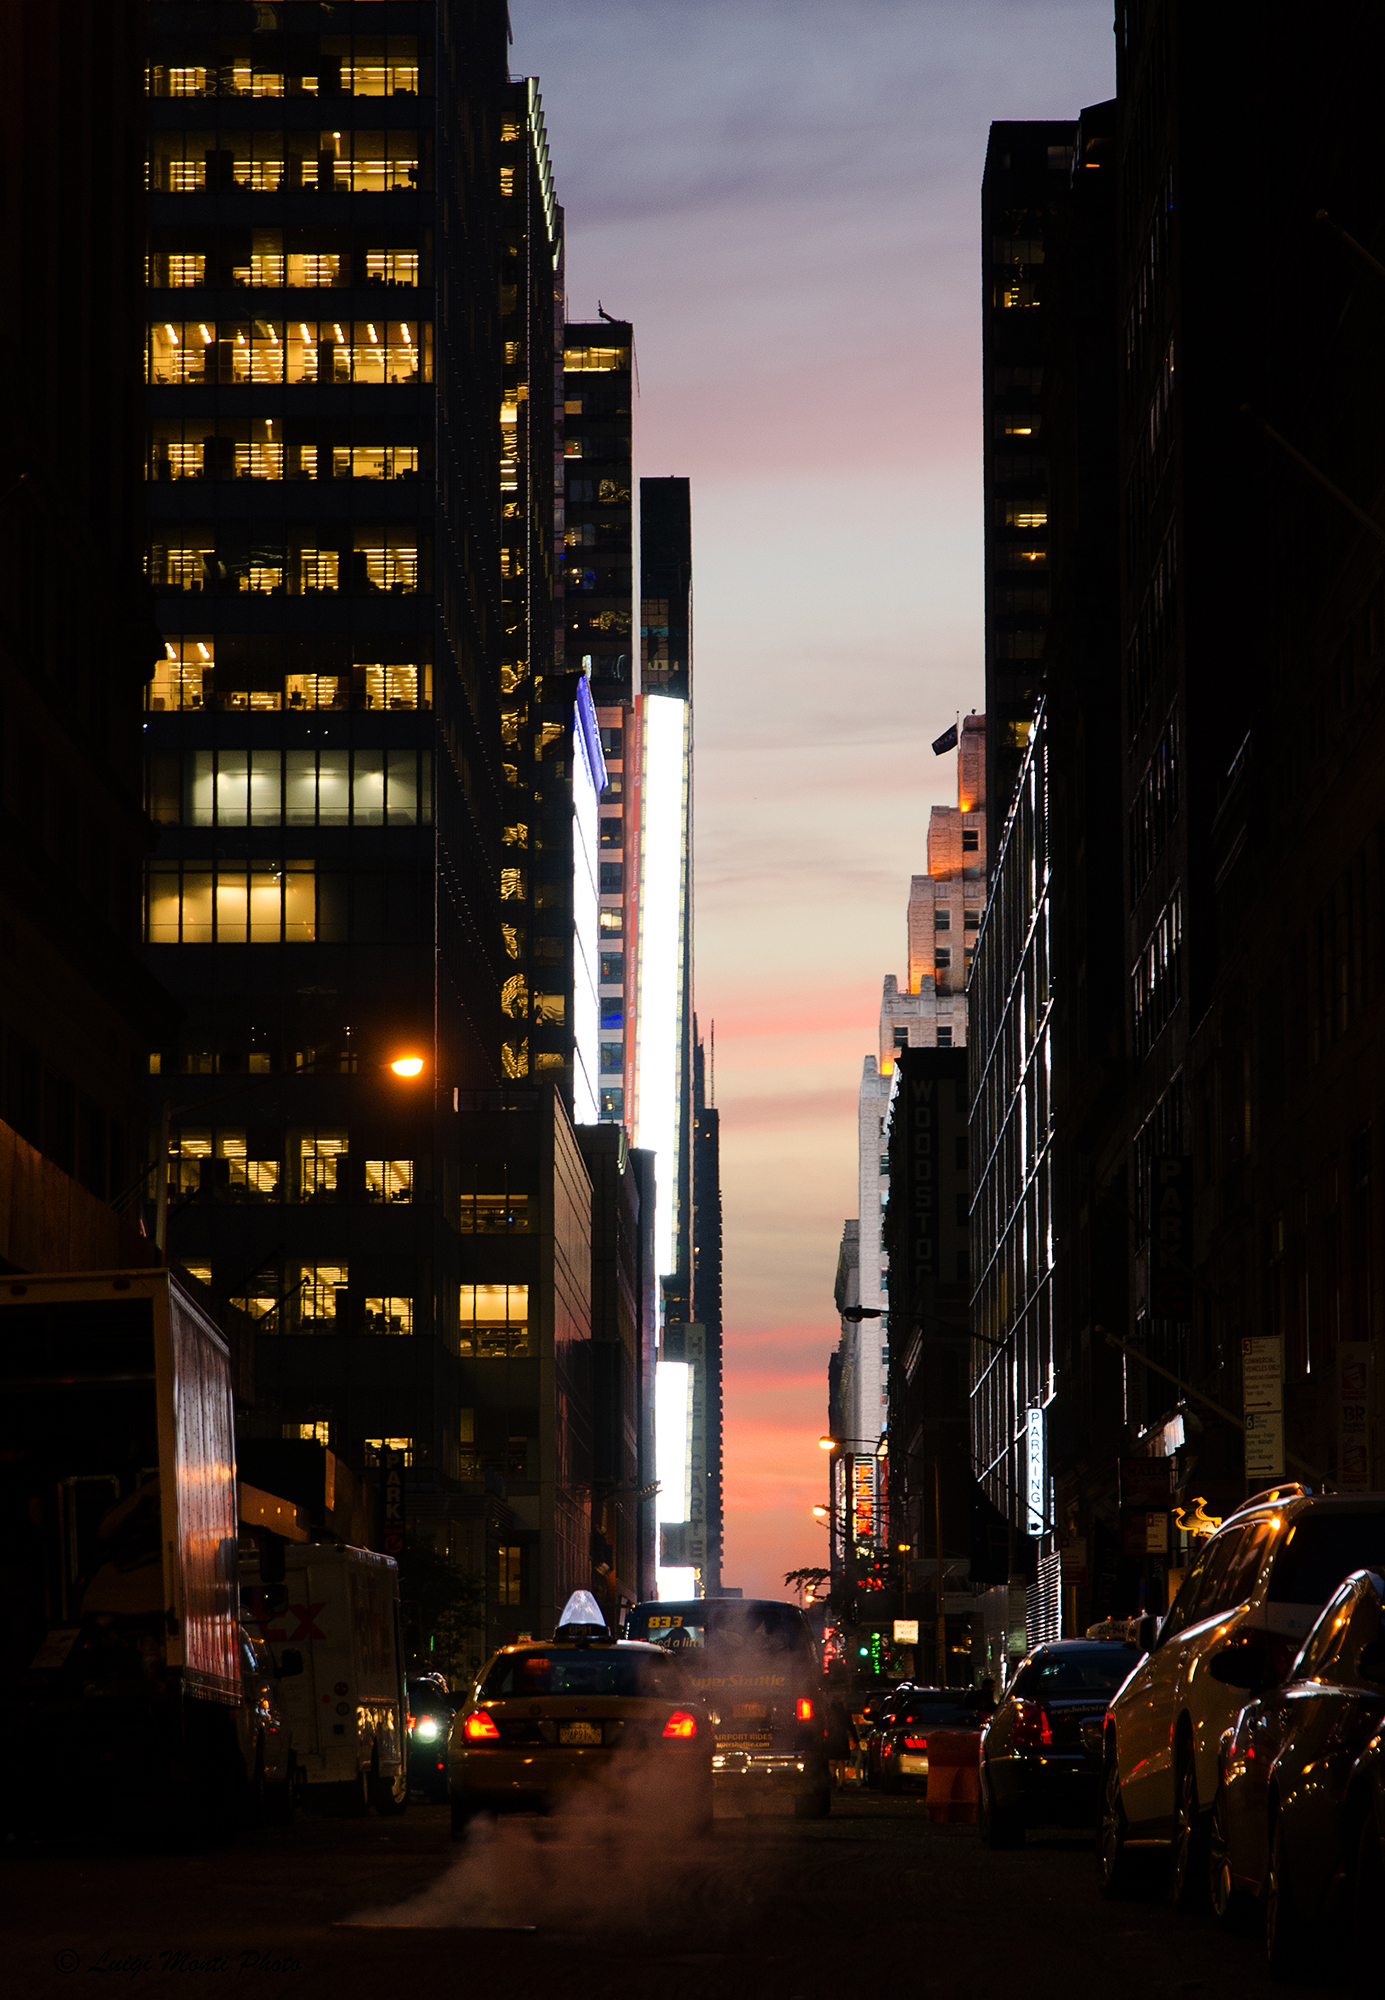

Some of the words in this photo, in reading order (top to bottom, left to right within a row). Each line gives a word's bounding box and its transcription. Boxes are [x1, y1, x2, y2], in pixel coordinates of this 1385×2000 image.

[1159, 1159, 1184, 1269] PARK
[1343, 1405, 1365, 1421] BR
[1245, 1415, 1253, 1429] 6
[1030, 1412, 1041, 1504] PARKING
[1128, 1466, 1167, 1476] NAILS
[385, 1453, 402, 1519] PARK
[856, 1465, 873, 1535] PARK
[648, 1615, 683, 1628] 833
[568, 1625, 592, 1635] 6P91
[672, 1639, 680, 1647] a
[688, 1674, 786, 1690] uperShuttle
